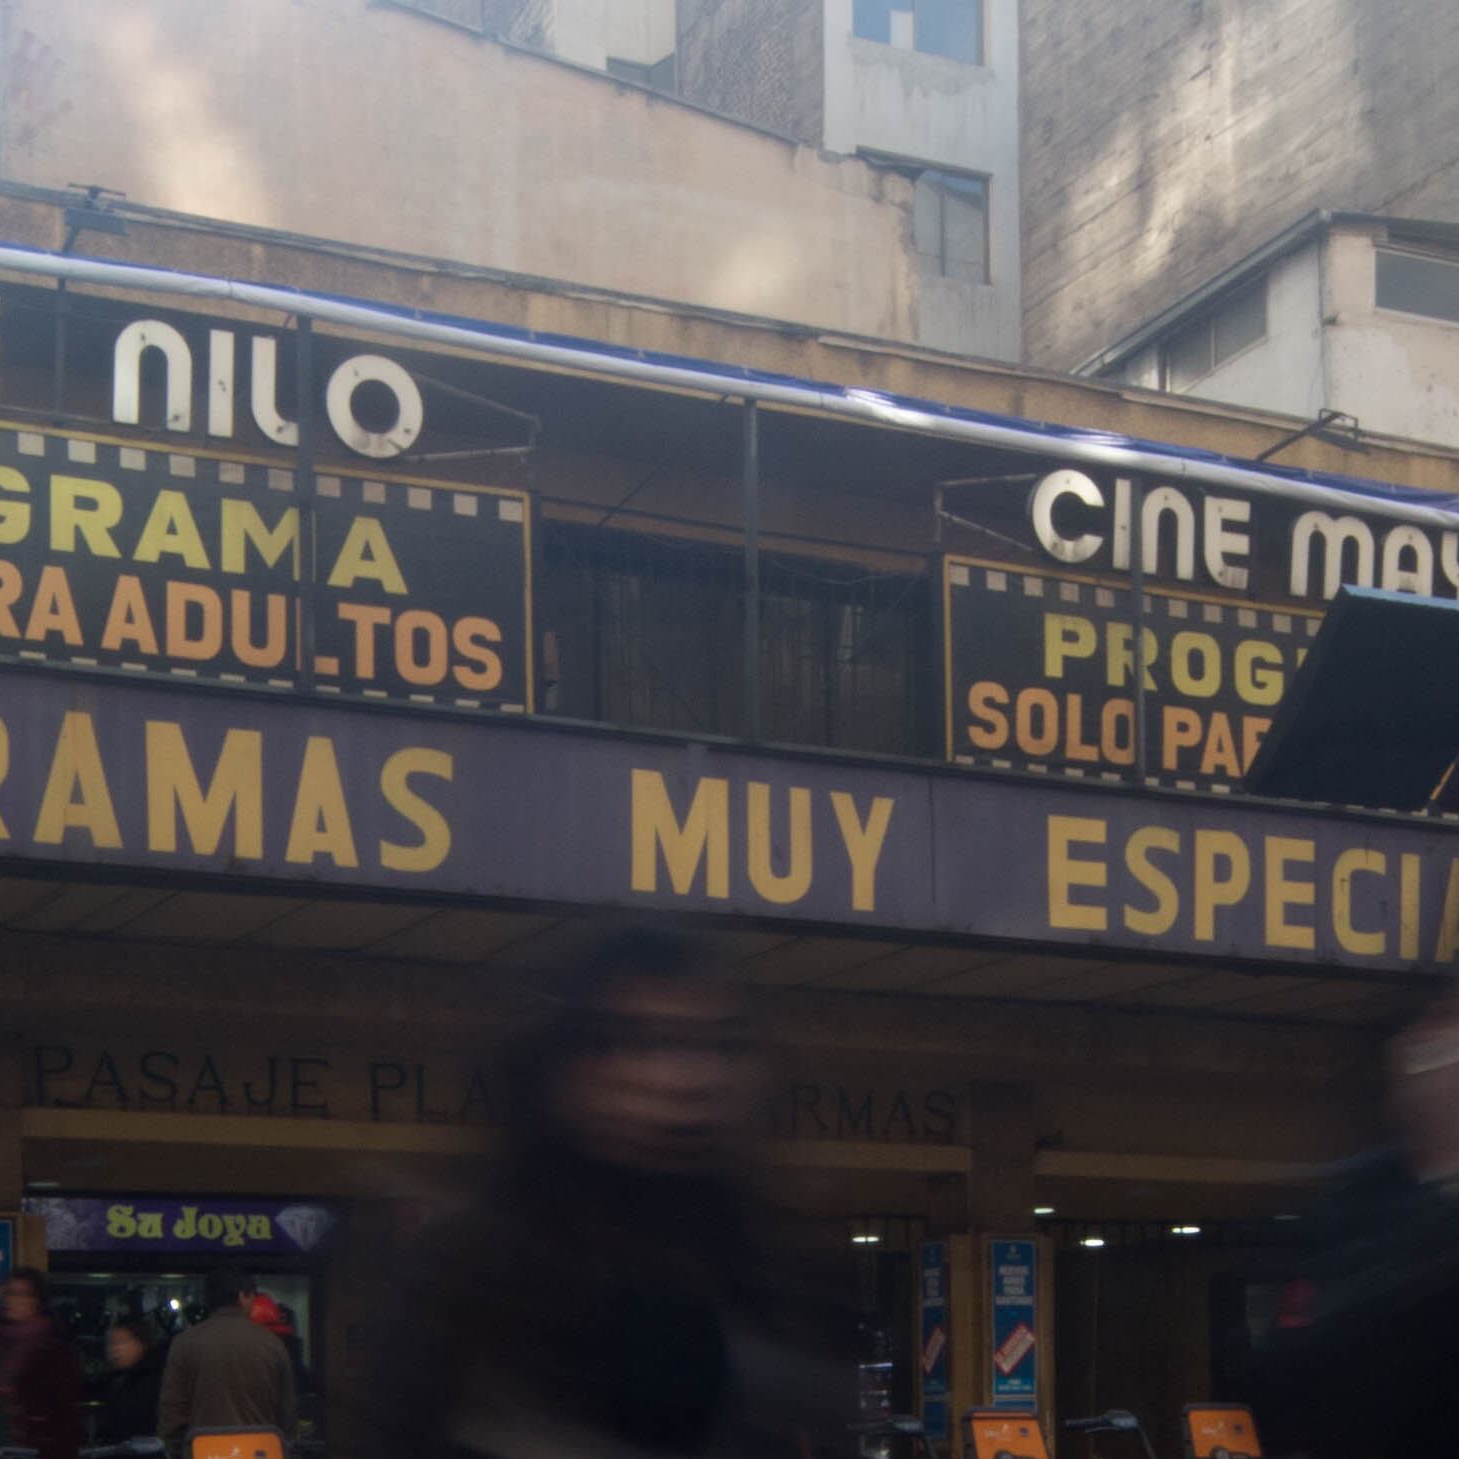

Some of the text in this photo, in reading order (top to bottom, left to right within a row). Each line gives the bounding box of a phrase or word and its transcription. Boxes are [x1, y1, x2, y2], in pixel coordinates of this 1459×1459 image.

[112, 320, 425, 460] NILO
[1031, 469, 1251, 590] CINE
[1043, 612, 1310, 708] PROG
[967, 681, 1135, 766] SOLO
[629, 768, 895, 912] MUY
[33, 1044, 331, 1118] PASAJE
[173, 1205, 273, 1247] Joya
